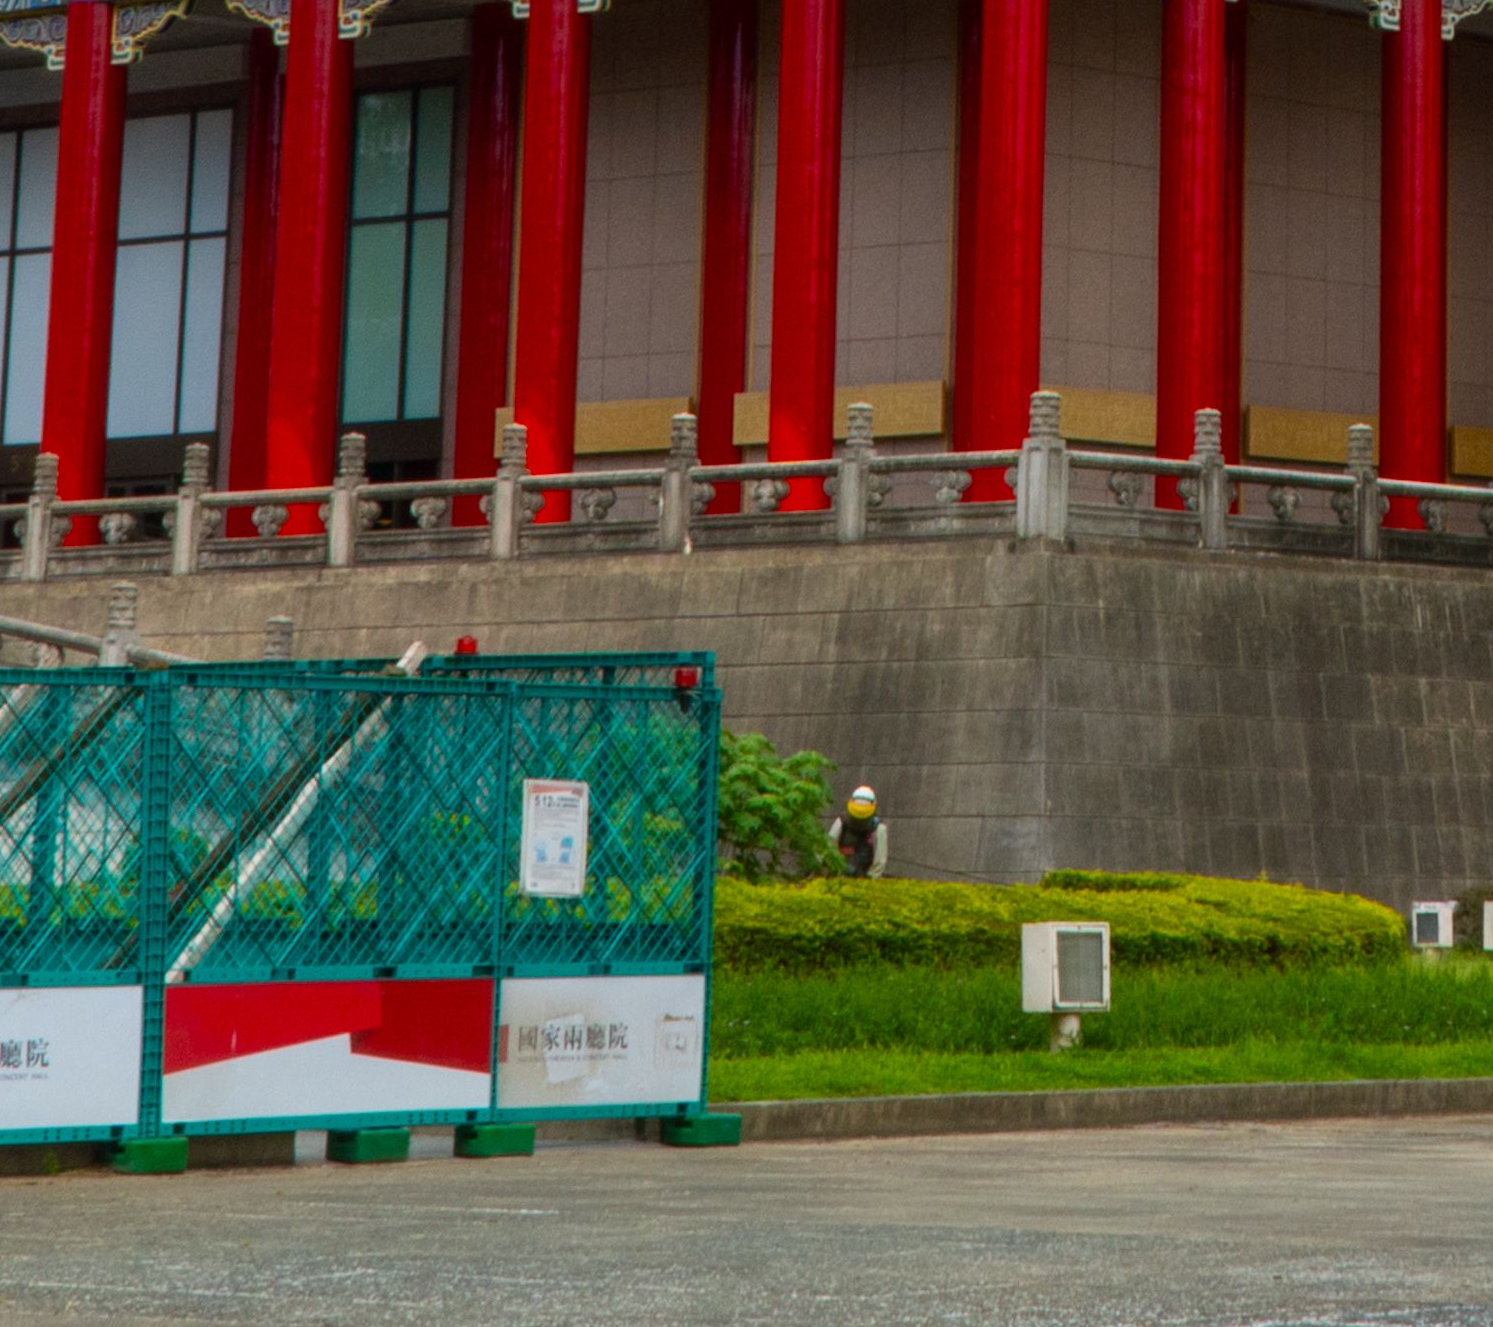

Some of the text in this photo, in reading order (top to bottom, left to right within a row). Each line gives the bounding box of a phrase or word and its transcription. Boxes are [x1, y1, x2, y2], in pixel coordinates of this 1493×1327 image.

[518, 1022, 629, 1051] 國家兩廳院
